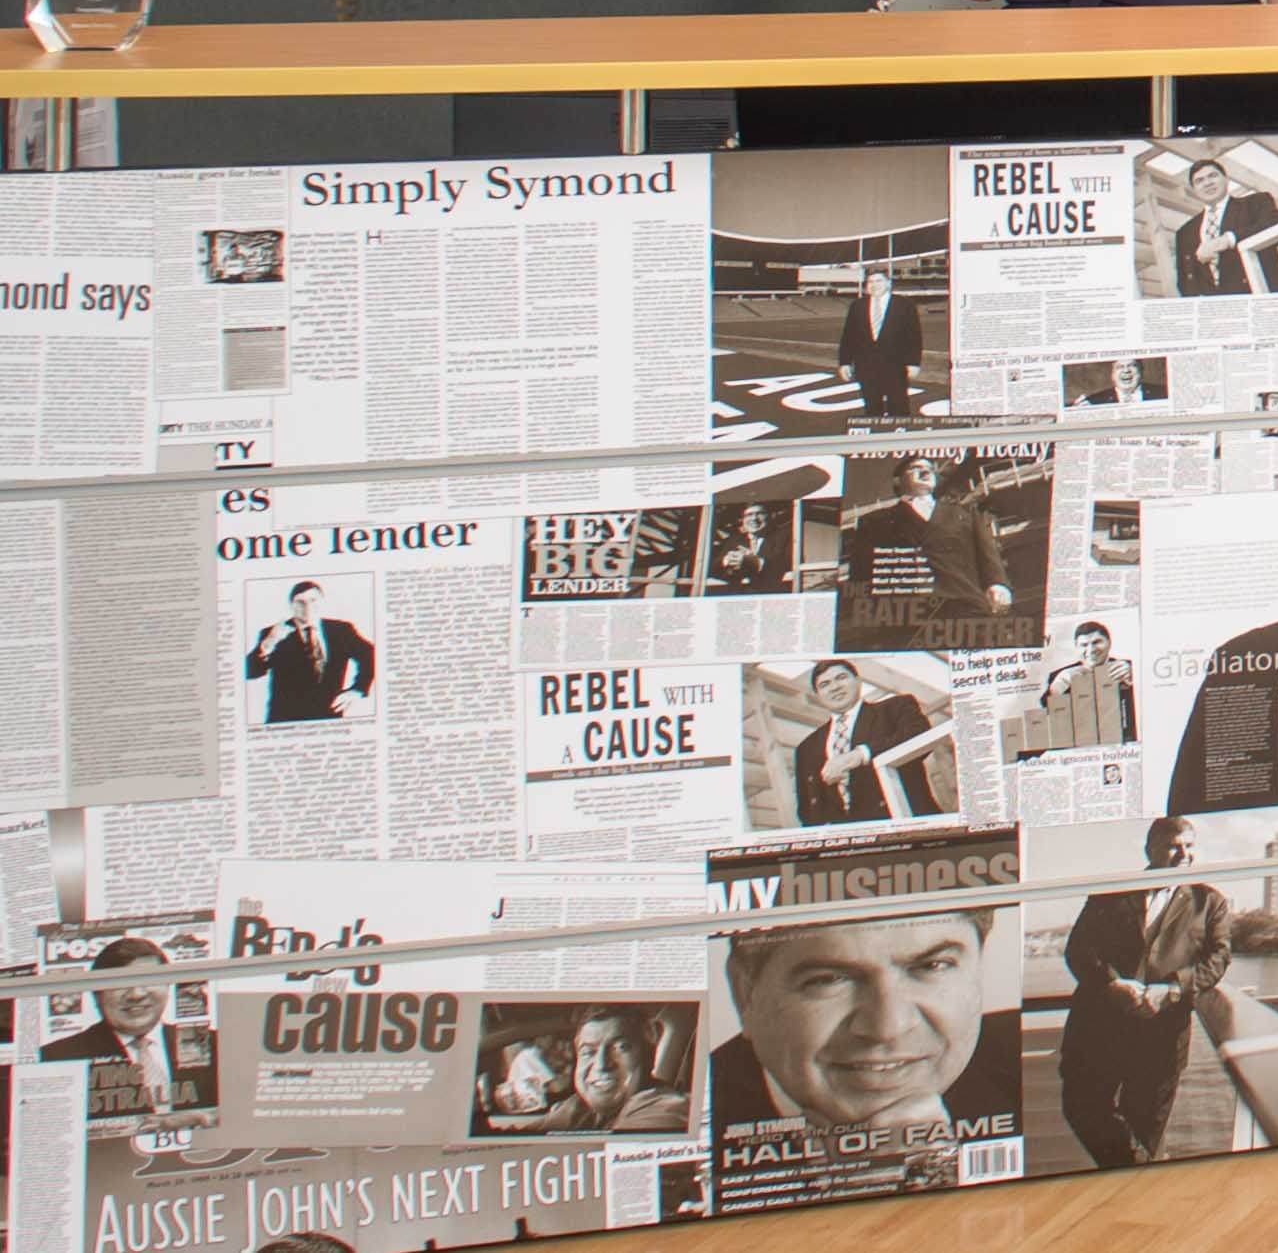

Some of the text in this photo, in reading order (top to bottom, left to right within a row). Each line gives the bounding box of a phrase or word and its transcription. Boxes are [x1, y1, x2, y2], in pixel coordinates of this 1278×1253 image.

[302, 161, 676, 216] Simply Symond
[973, 160, 1112, 197] REBEL WITH
[990, 200, 1096, 238] A CAUSE
[80, 283, 152, 321] says
[214, 441, 255, 461] TY
[329, 519, 480, 555] lender
[529, 513, 638, 545] HEY
[529, 543, 630, 580] BIG
[530, 577, 631, 596] LENDER
[852, 596, 925, 627] RATE
[951, 649, 1042, 672] to help end the
[952, 668, 1028, 689] secret deals
[540, 668, 715, 716] REBEL WITH
[561, 714, 696, 764] A CAUSE
[263, 991, 460, 1054] cause
[721, 1112, 1015, 1168] HALL OF FAME
[95, 1149, 606, 1253] AUSSIE JOHN'S NEXT FIGHT
